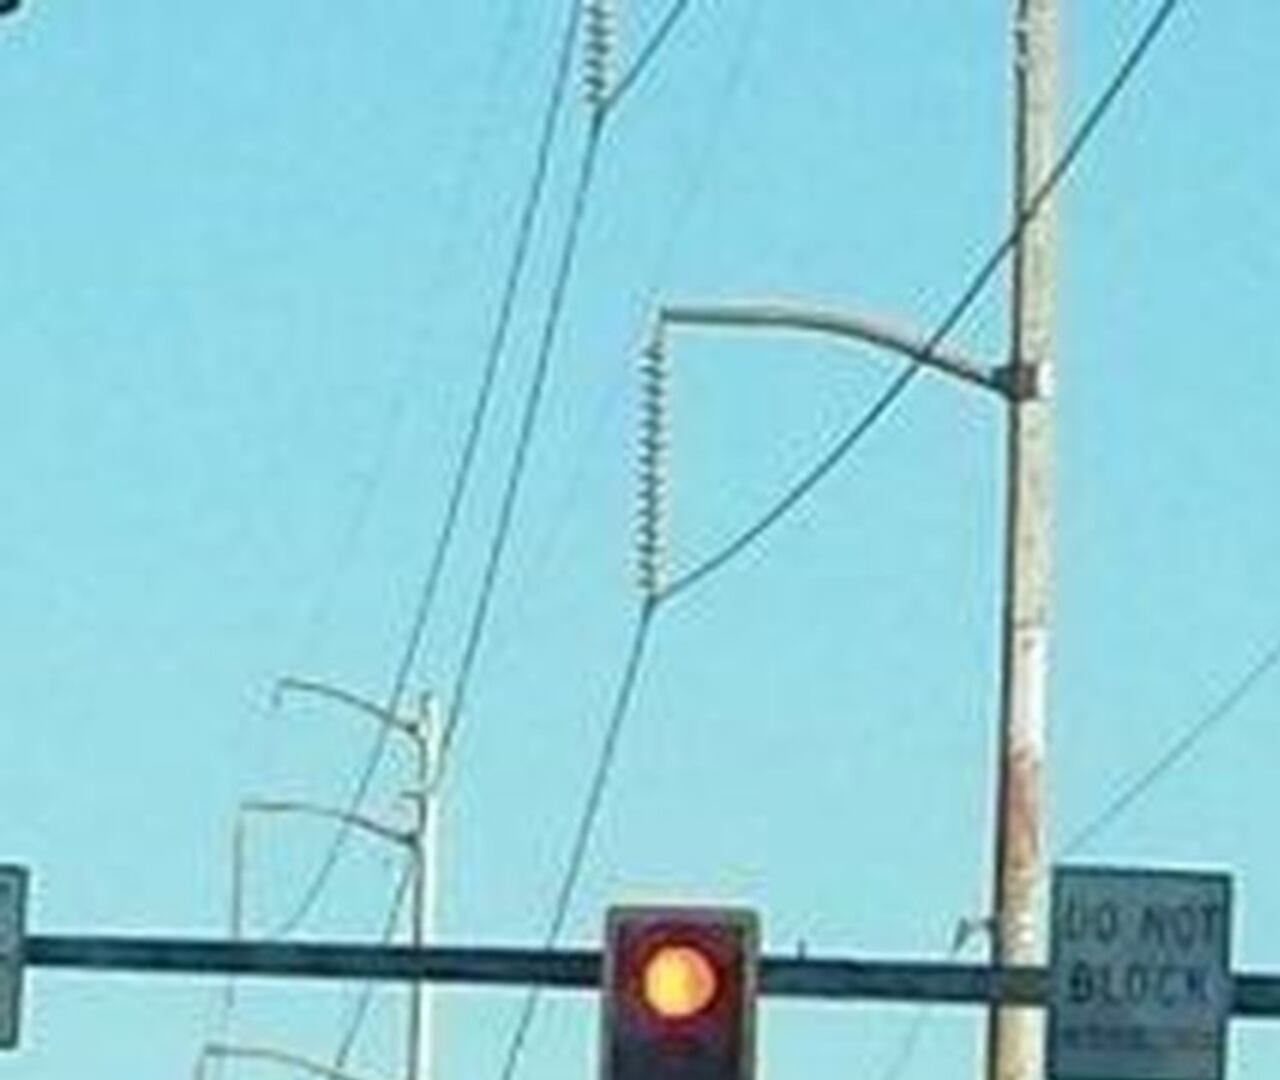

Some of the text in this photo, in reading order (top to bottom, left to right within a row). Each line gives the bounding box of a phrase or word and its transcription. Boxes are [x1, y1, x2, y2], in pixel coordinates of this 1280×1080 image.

[1064, 898, 1220, 951] DO NOT
[1068, 959, 1210, 1008] BLOCK
